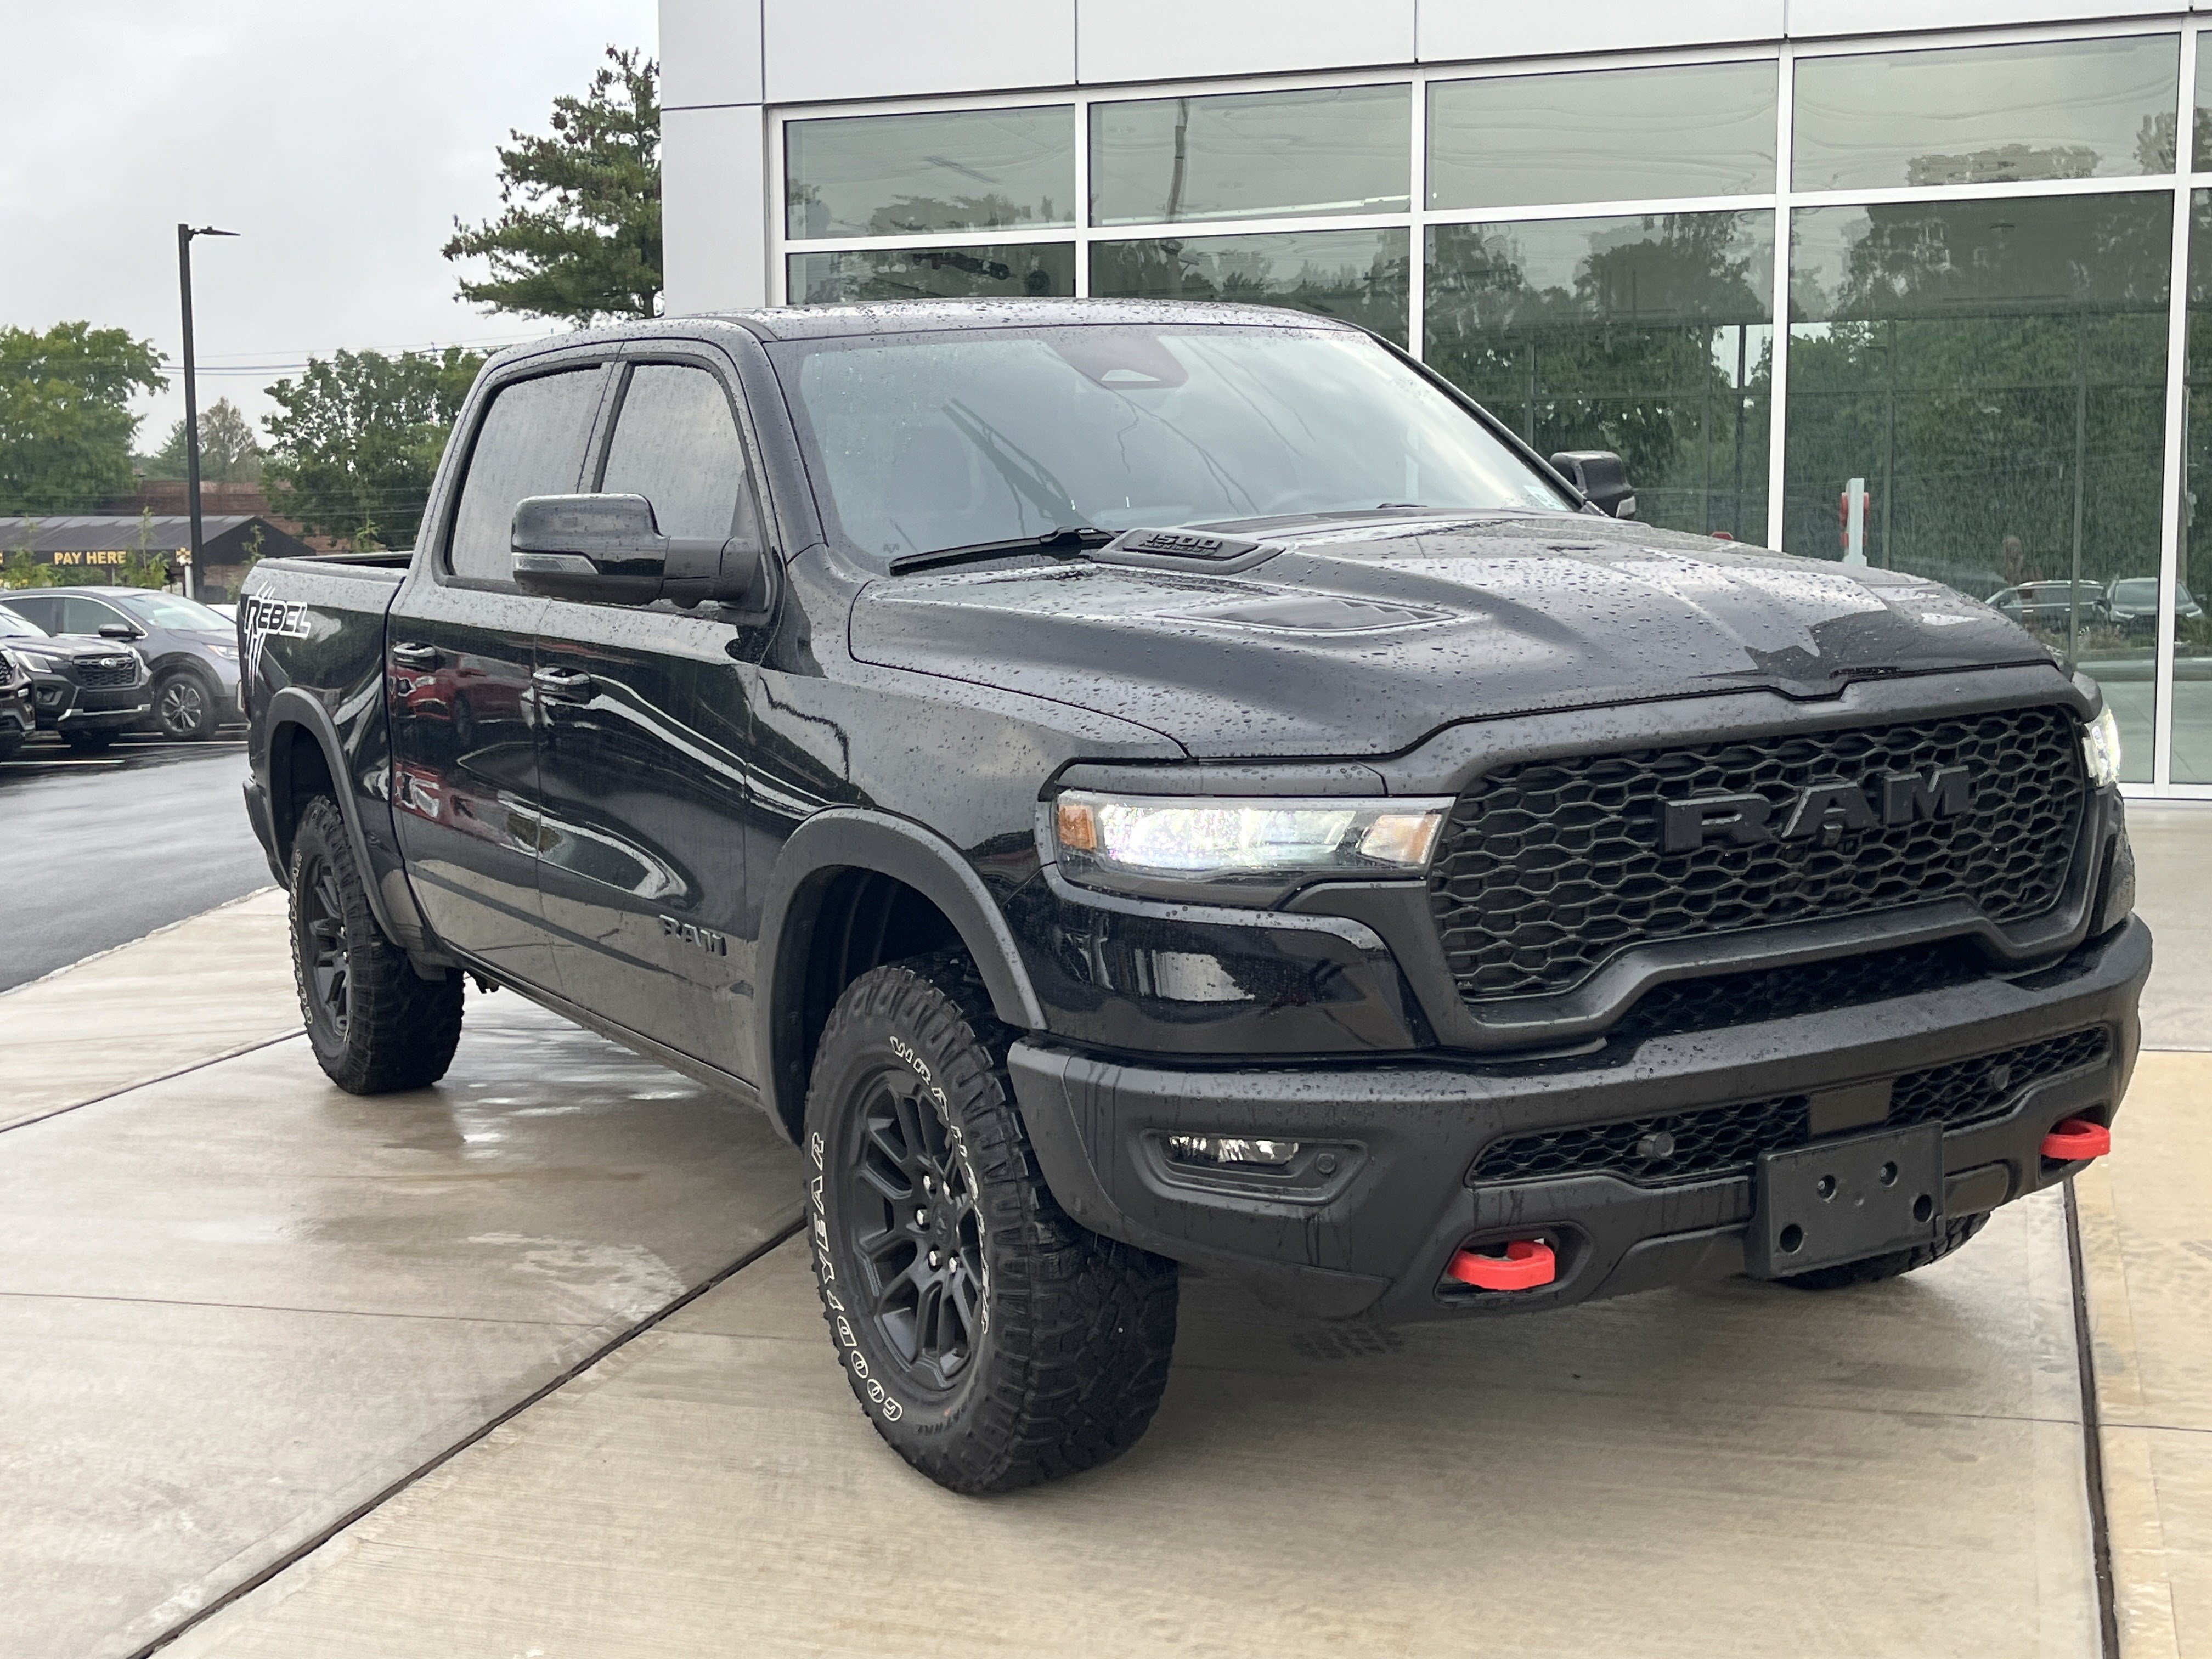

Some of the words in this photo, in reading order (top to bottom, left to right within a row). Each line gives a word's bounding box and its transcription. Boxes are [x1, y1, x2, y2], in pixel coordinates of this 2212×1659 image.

[54, 551, 81, 565] PAY
[86, 550, 127, 565] HERE
[1146, 534, 1223, 550] 1500
[244, 595, 311, 639] REBEL
[1662, 765, 1970, 853] RAM
[659, 913, 727, 956] RAM
[810, 1132, 902, 1423] GOODYEAR
